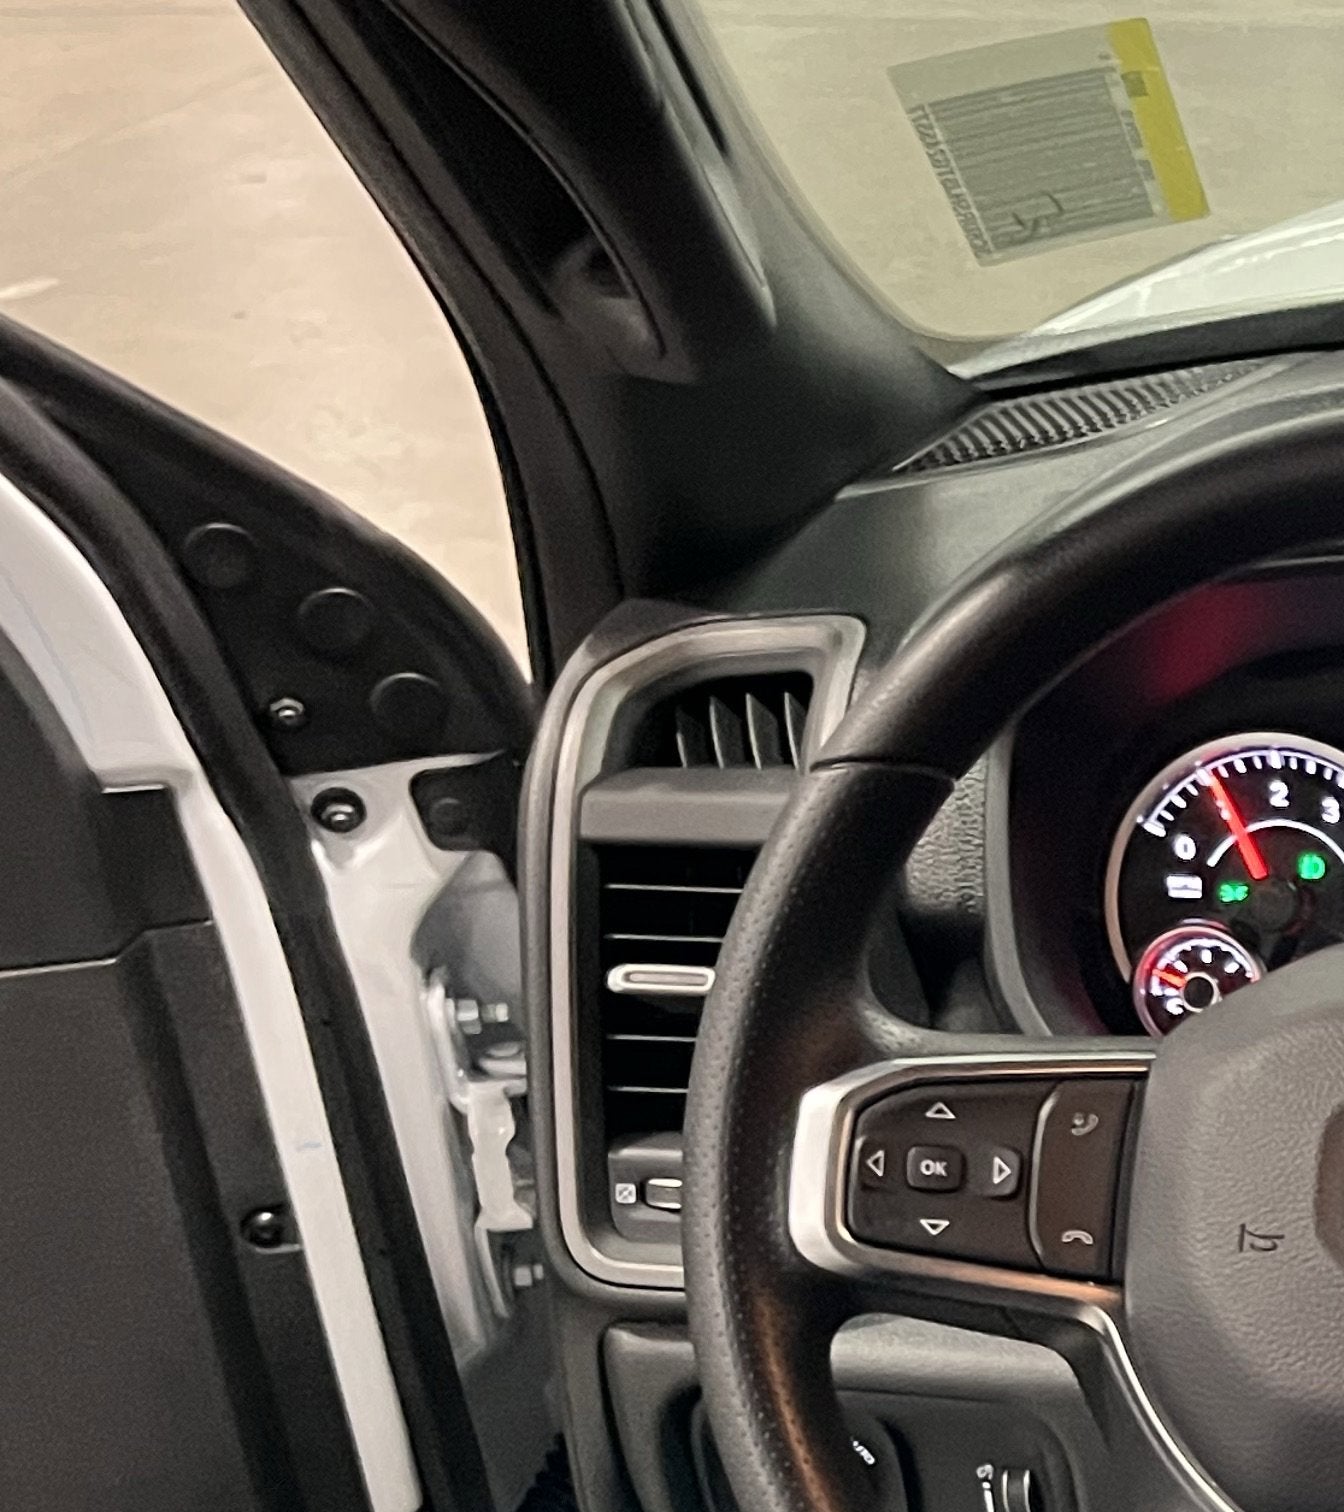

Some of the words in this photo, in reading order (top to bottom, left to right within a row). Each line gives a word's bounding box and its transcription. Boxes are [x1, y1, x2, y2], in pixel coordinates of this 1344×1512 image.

[1269, 779, 1289, 807] 2
[1321, 797, 1340, 824] 3
[1174, 834, 1196, 860] 0
[919, 1158, 948, 1178] OK
